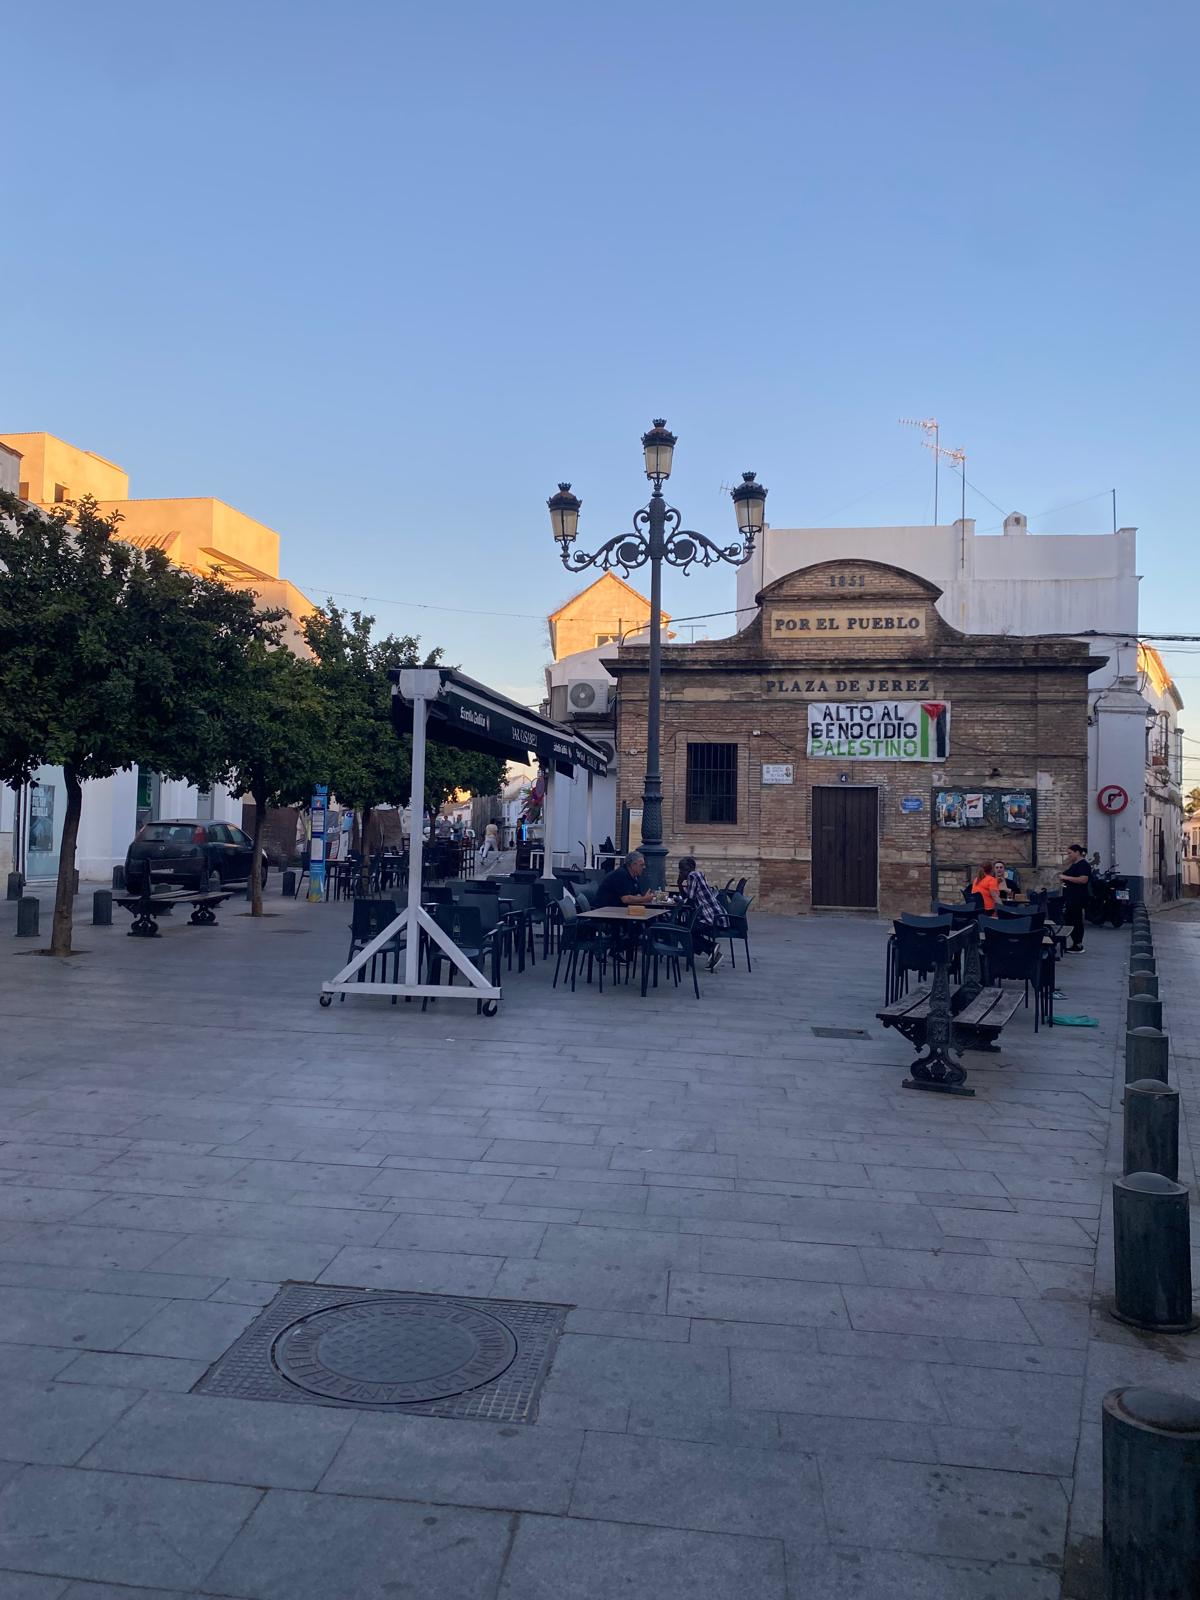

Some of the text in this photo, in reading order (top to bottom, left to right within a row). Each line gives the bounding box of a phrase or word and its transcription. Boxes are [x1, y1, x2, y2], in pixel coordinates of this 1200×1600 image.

[775, 616, 920, 631] POR EL PUEBLO
[766, 679, 930, 693] PLAZA DE JEREZ
[822, 704, 905, 722] ALTO AL
[811, 722, 918, 740] GENOCIDIO
[810, 739, 918, 757] PALESTINO
